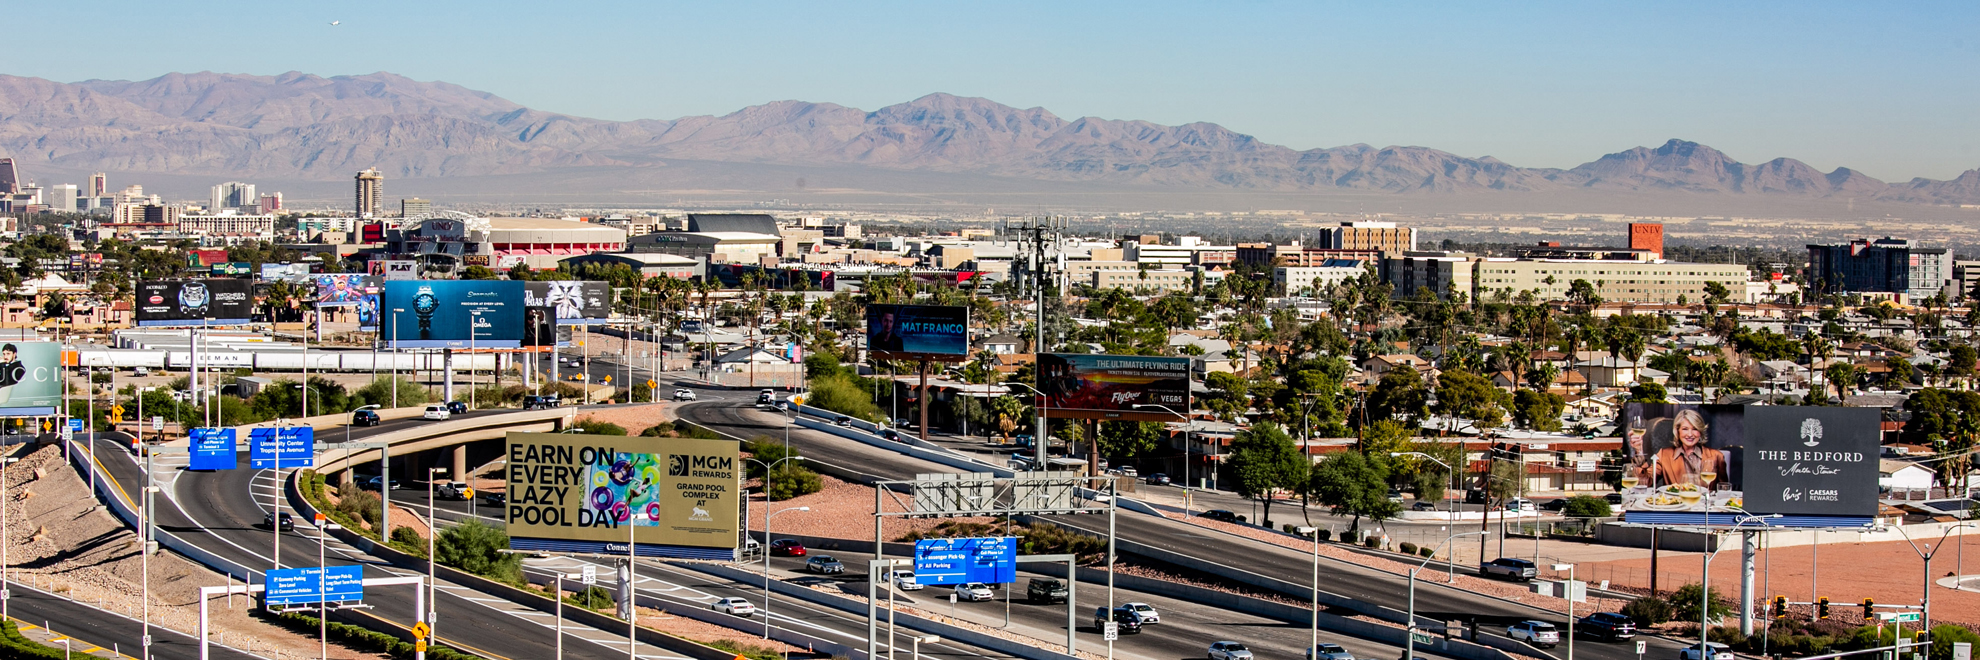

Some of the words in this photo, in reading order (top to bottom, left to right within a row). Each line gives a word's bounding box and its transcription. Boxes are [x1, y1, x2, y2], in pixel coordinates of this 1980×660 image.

[1634, 226, 1660, 234] UNLV
[902, 322, 921, 332] MAT
[923, 323, 964, 334] FRANCO
[1111, 360, 1143, 369] ULTIMATE
[1111, 392, 1141, 404] FlyOver
[510, 444, 573, 464] EARN
[579, 446, 614, 466] ON
[1759, 450, 1788, 460] THE
[1794, 451, 1863, 462] BEDFORD
[692, 455, 732, 470] MGM
[510, 464, 583, 486] EVERY
[510, 485, 569, 506] LAZY
[682, 491, 720, 500] COMPLEX
[509, 505, 572, 527] POOL
[578, 508, 624, 529] DAY
